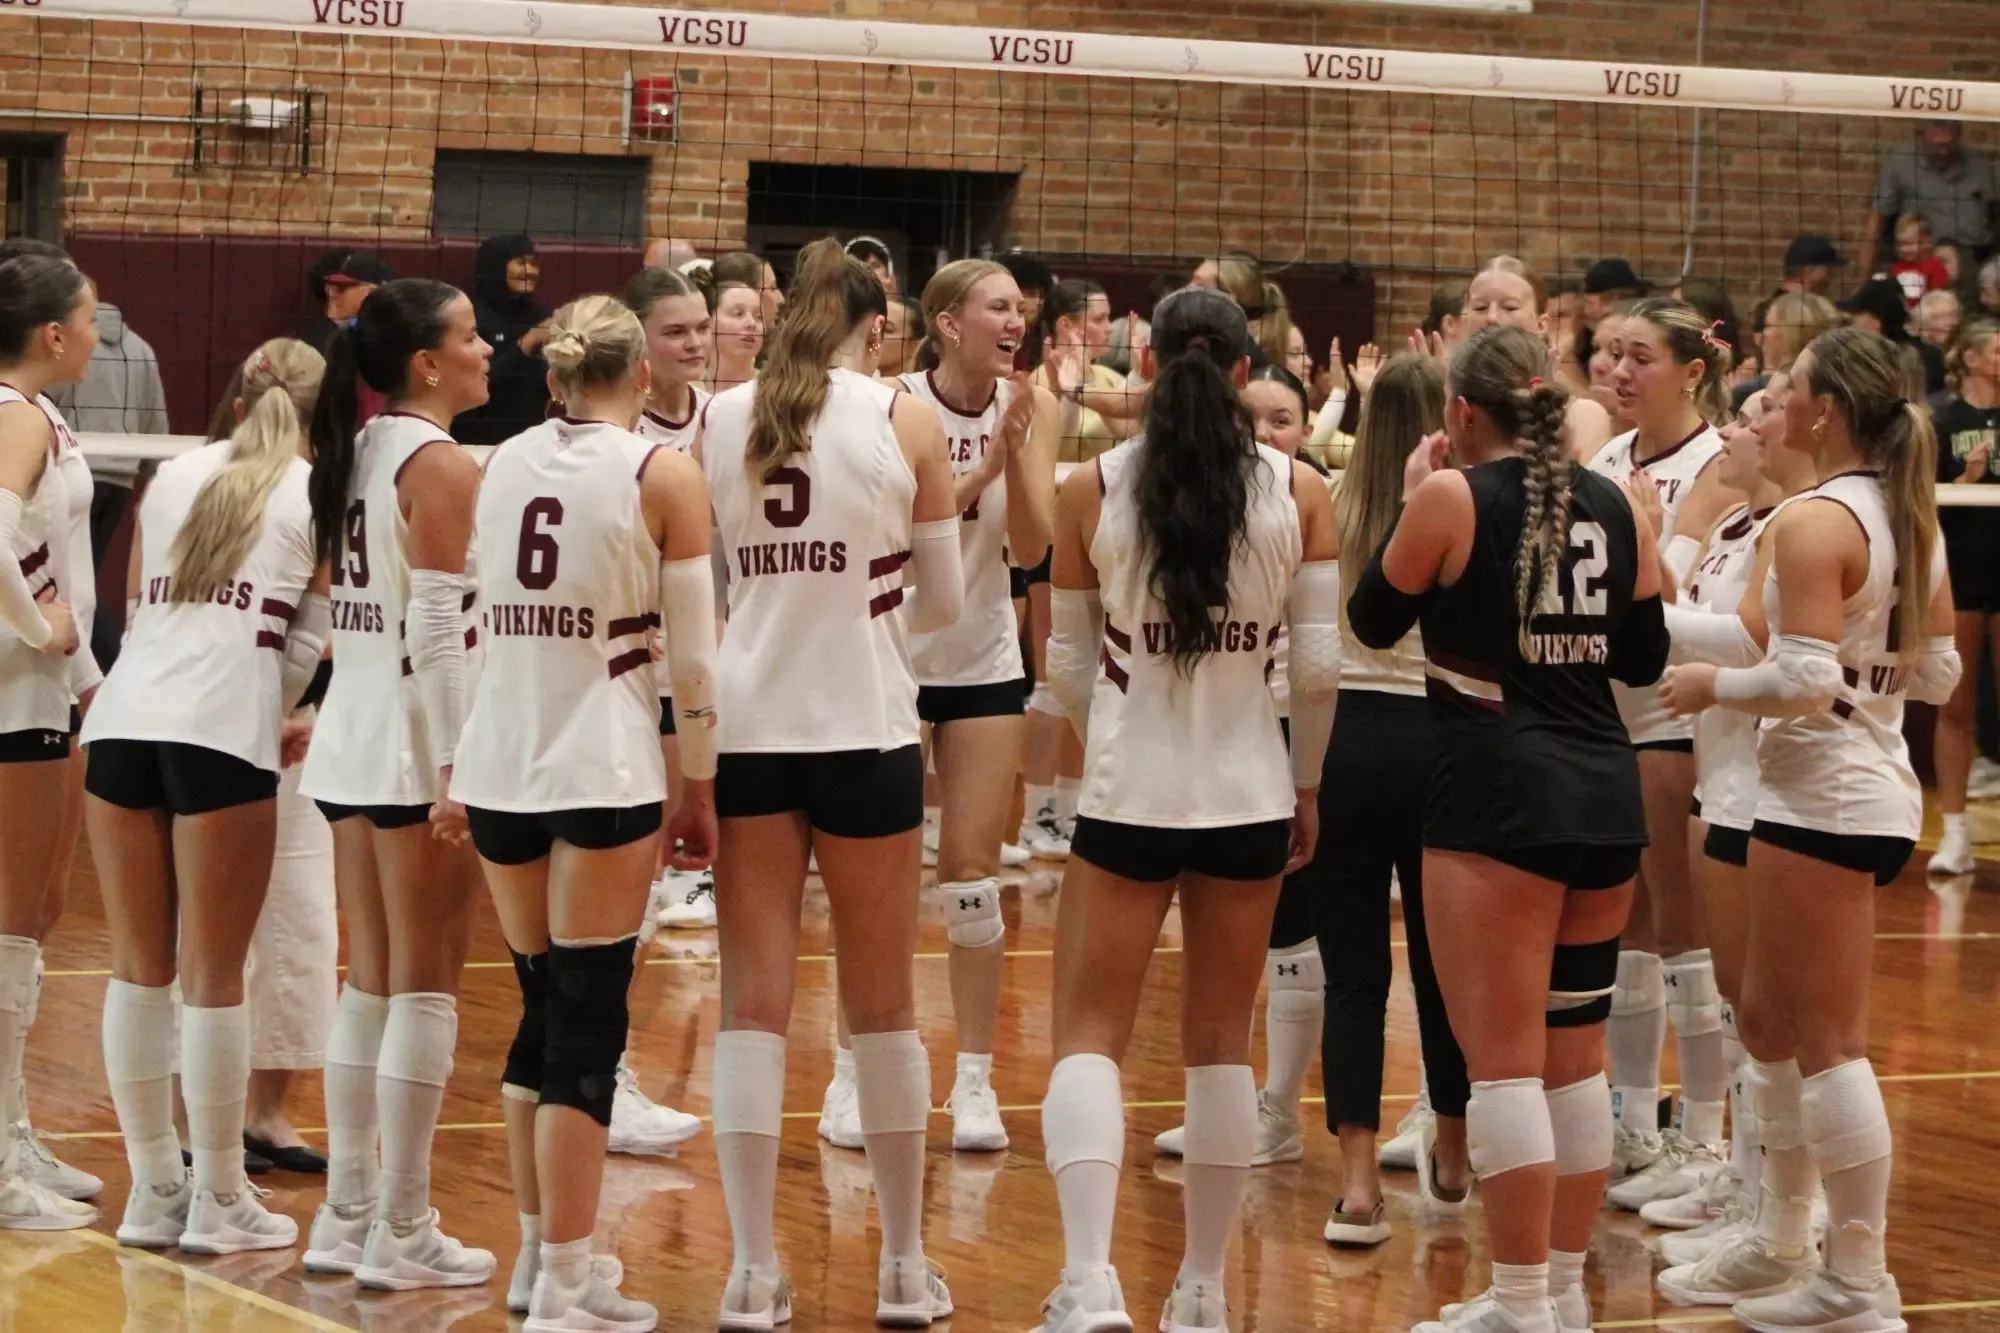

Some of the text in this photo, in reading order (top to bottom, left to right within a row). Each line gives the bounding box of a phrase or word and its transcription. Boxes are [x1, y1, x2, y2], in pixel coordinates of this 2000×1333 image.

[312, 0, 404, 27] VCSU
[658, 16, 747, 46] VCSU
[989, 35, 1073, 65] VCSU
[1304, 53, 1384, 81] VCSU
[1604, 69, 1681, 97] VCSU
[1890, 84, 1963, 112] VCSU
[516, 496, 564, 590] 6
[737, 540, 847, 578] VIKINGS
[1534, 521, 1608, 615] 12
[149, 576, 253, 610] VIGS
[331, 599, 384, 633] KINGS
[492, 604, 594, 639] VIKINGS
